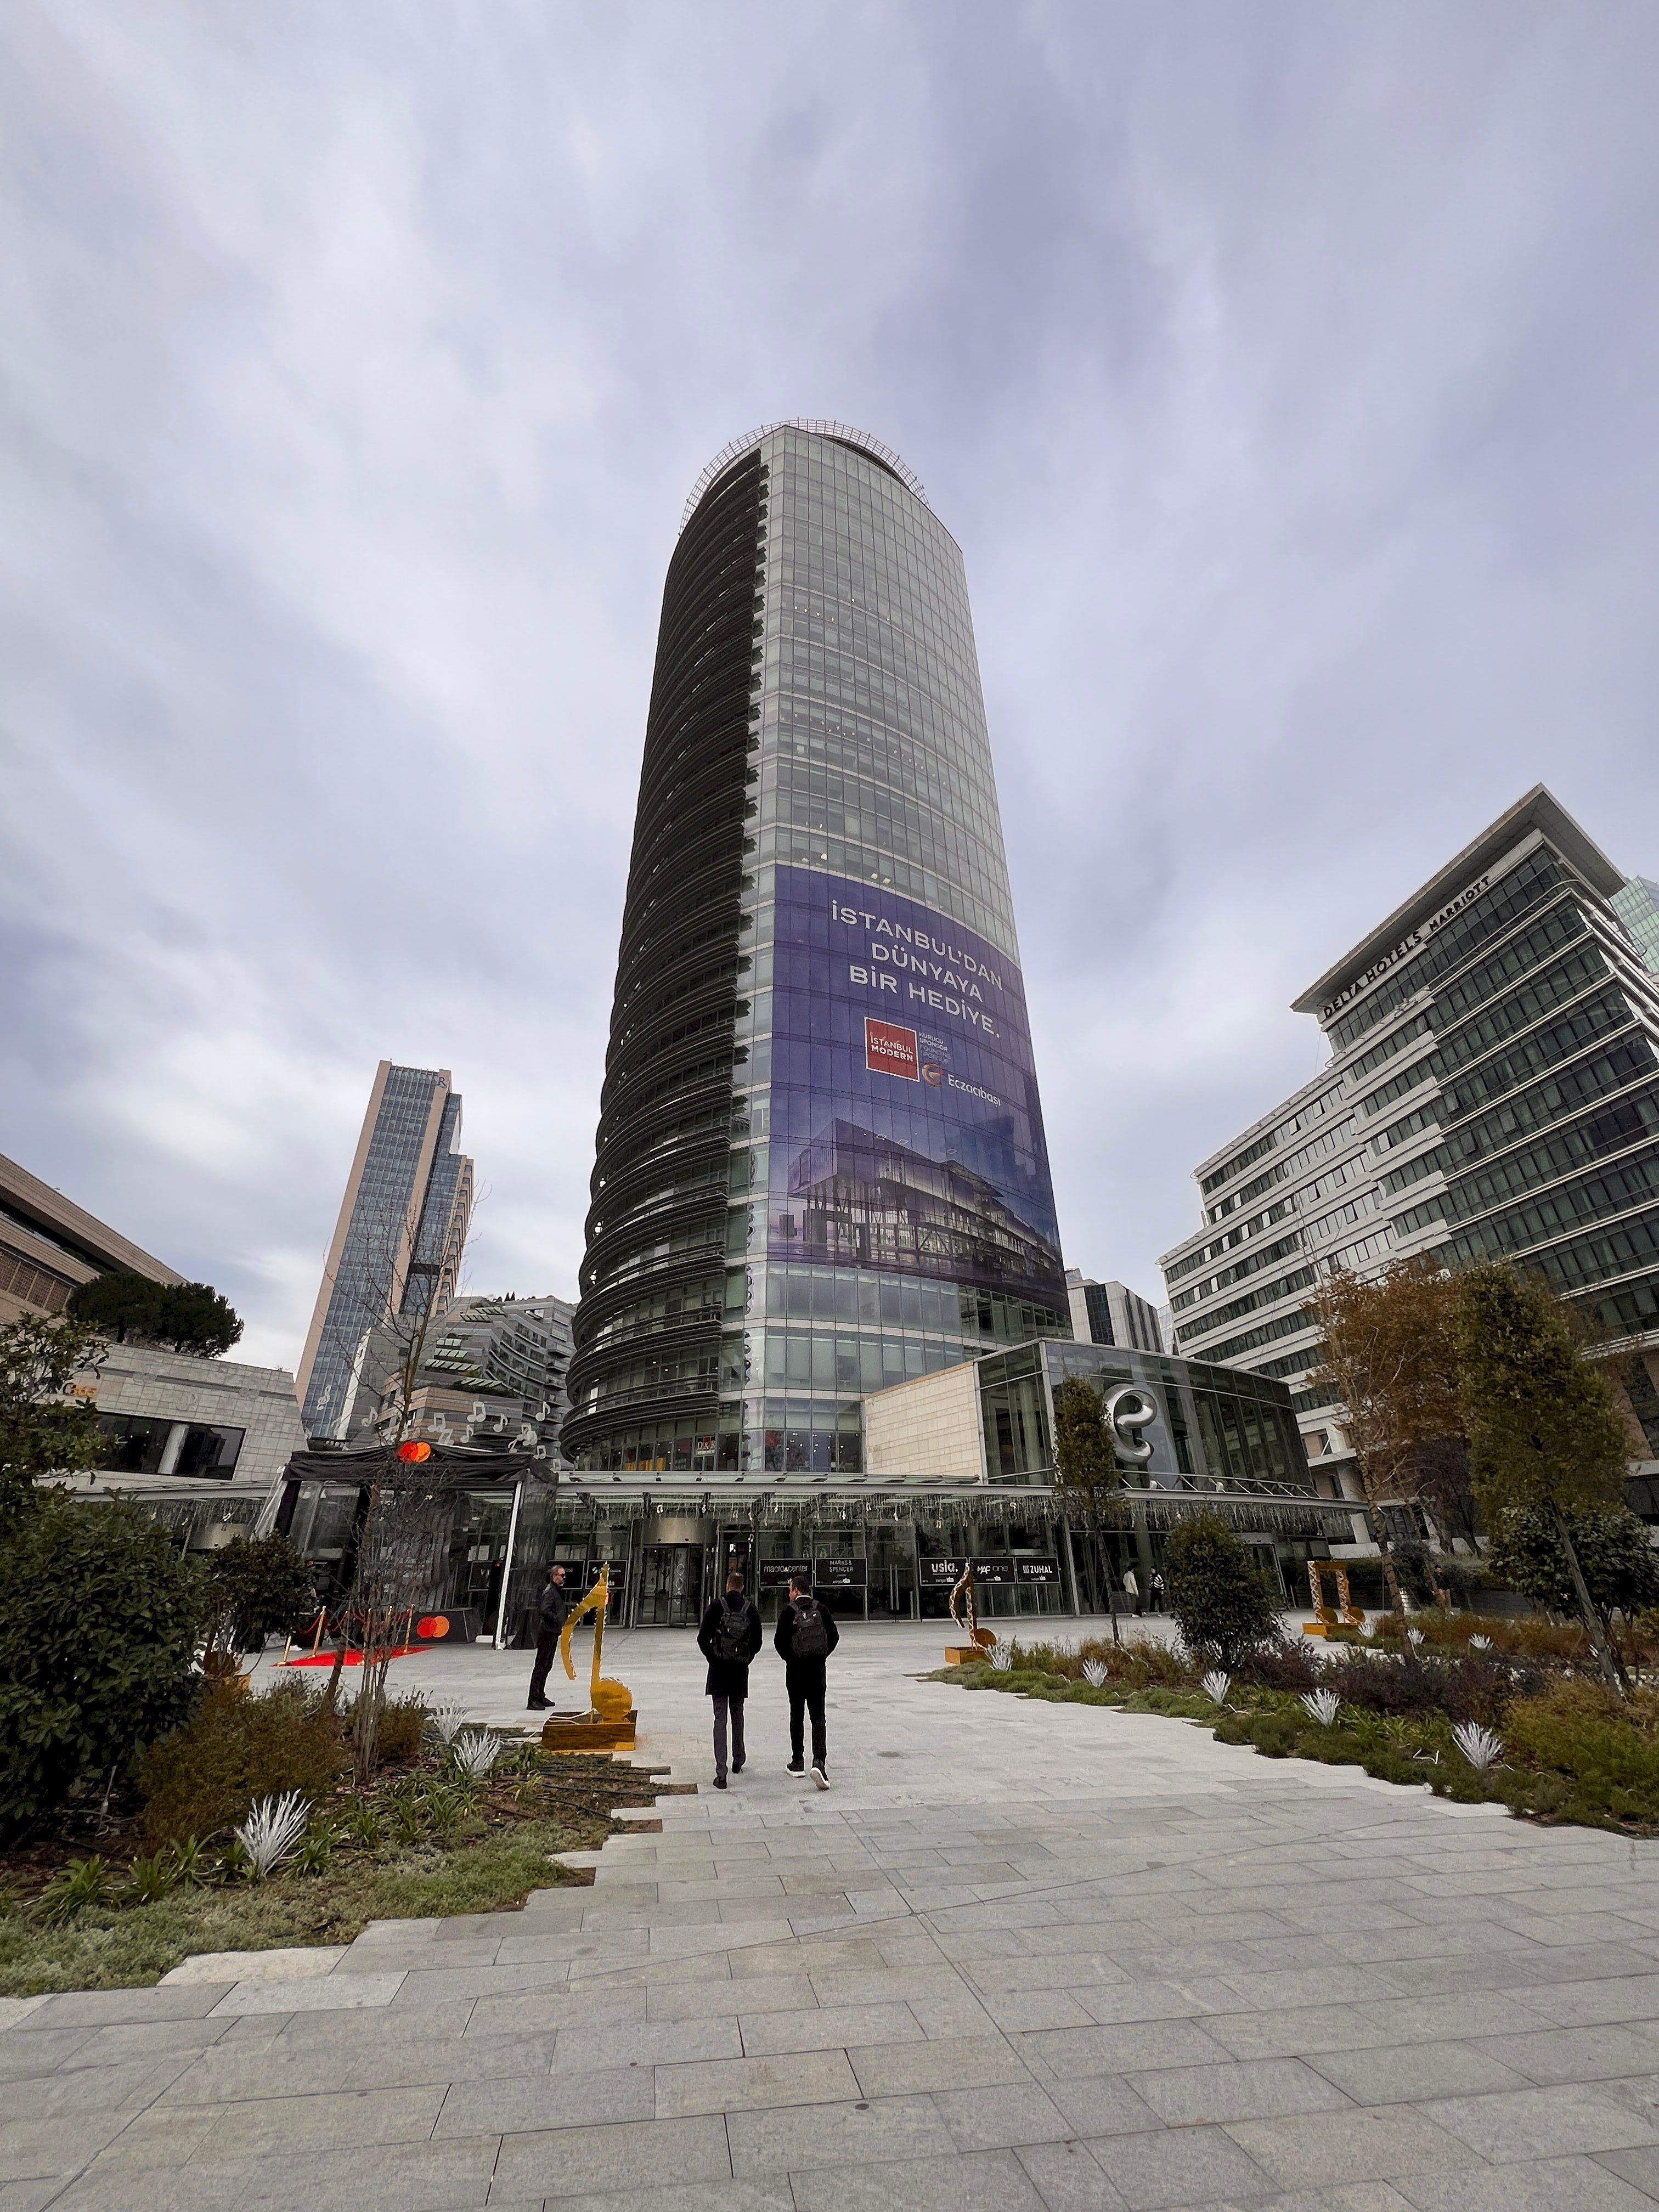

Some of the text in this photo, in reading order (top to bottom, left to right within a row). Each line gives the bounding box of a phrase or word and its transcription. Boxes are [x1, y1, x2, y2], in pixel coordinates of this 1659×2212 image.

[1323, 876, 1491, 1019] DELTA HOTELS MARRIOTT
[871, 943, 983, 1002] DÜNYAYA
[849, 965, 1001, 1039] BİR HEDİYE.
[918, 1032, 944, 1045] KURUCU
[919, 1038, 948, 1052] SPONSOR
[871, 1045, 913, 1062] MODERN
[947, 1074, 1001, 1107] Eczacıbaşı
[1030, 1565, 1053, 1573] ZUHAL
